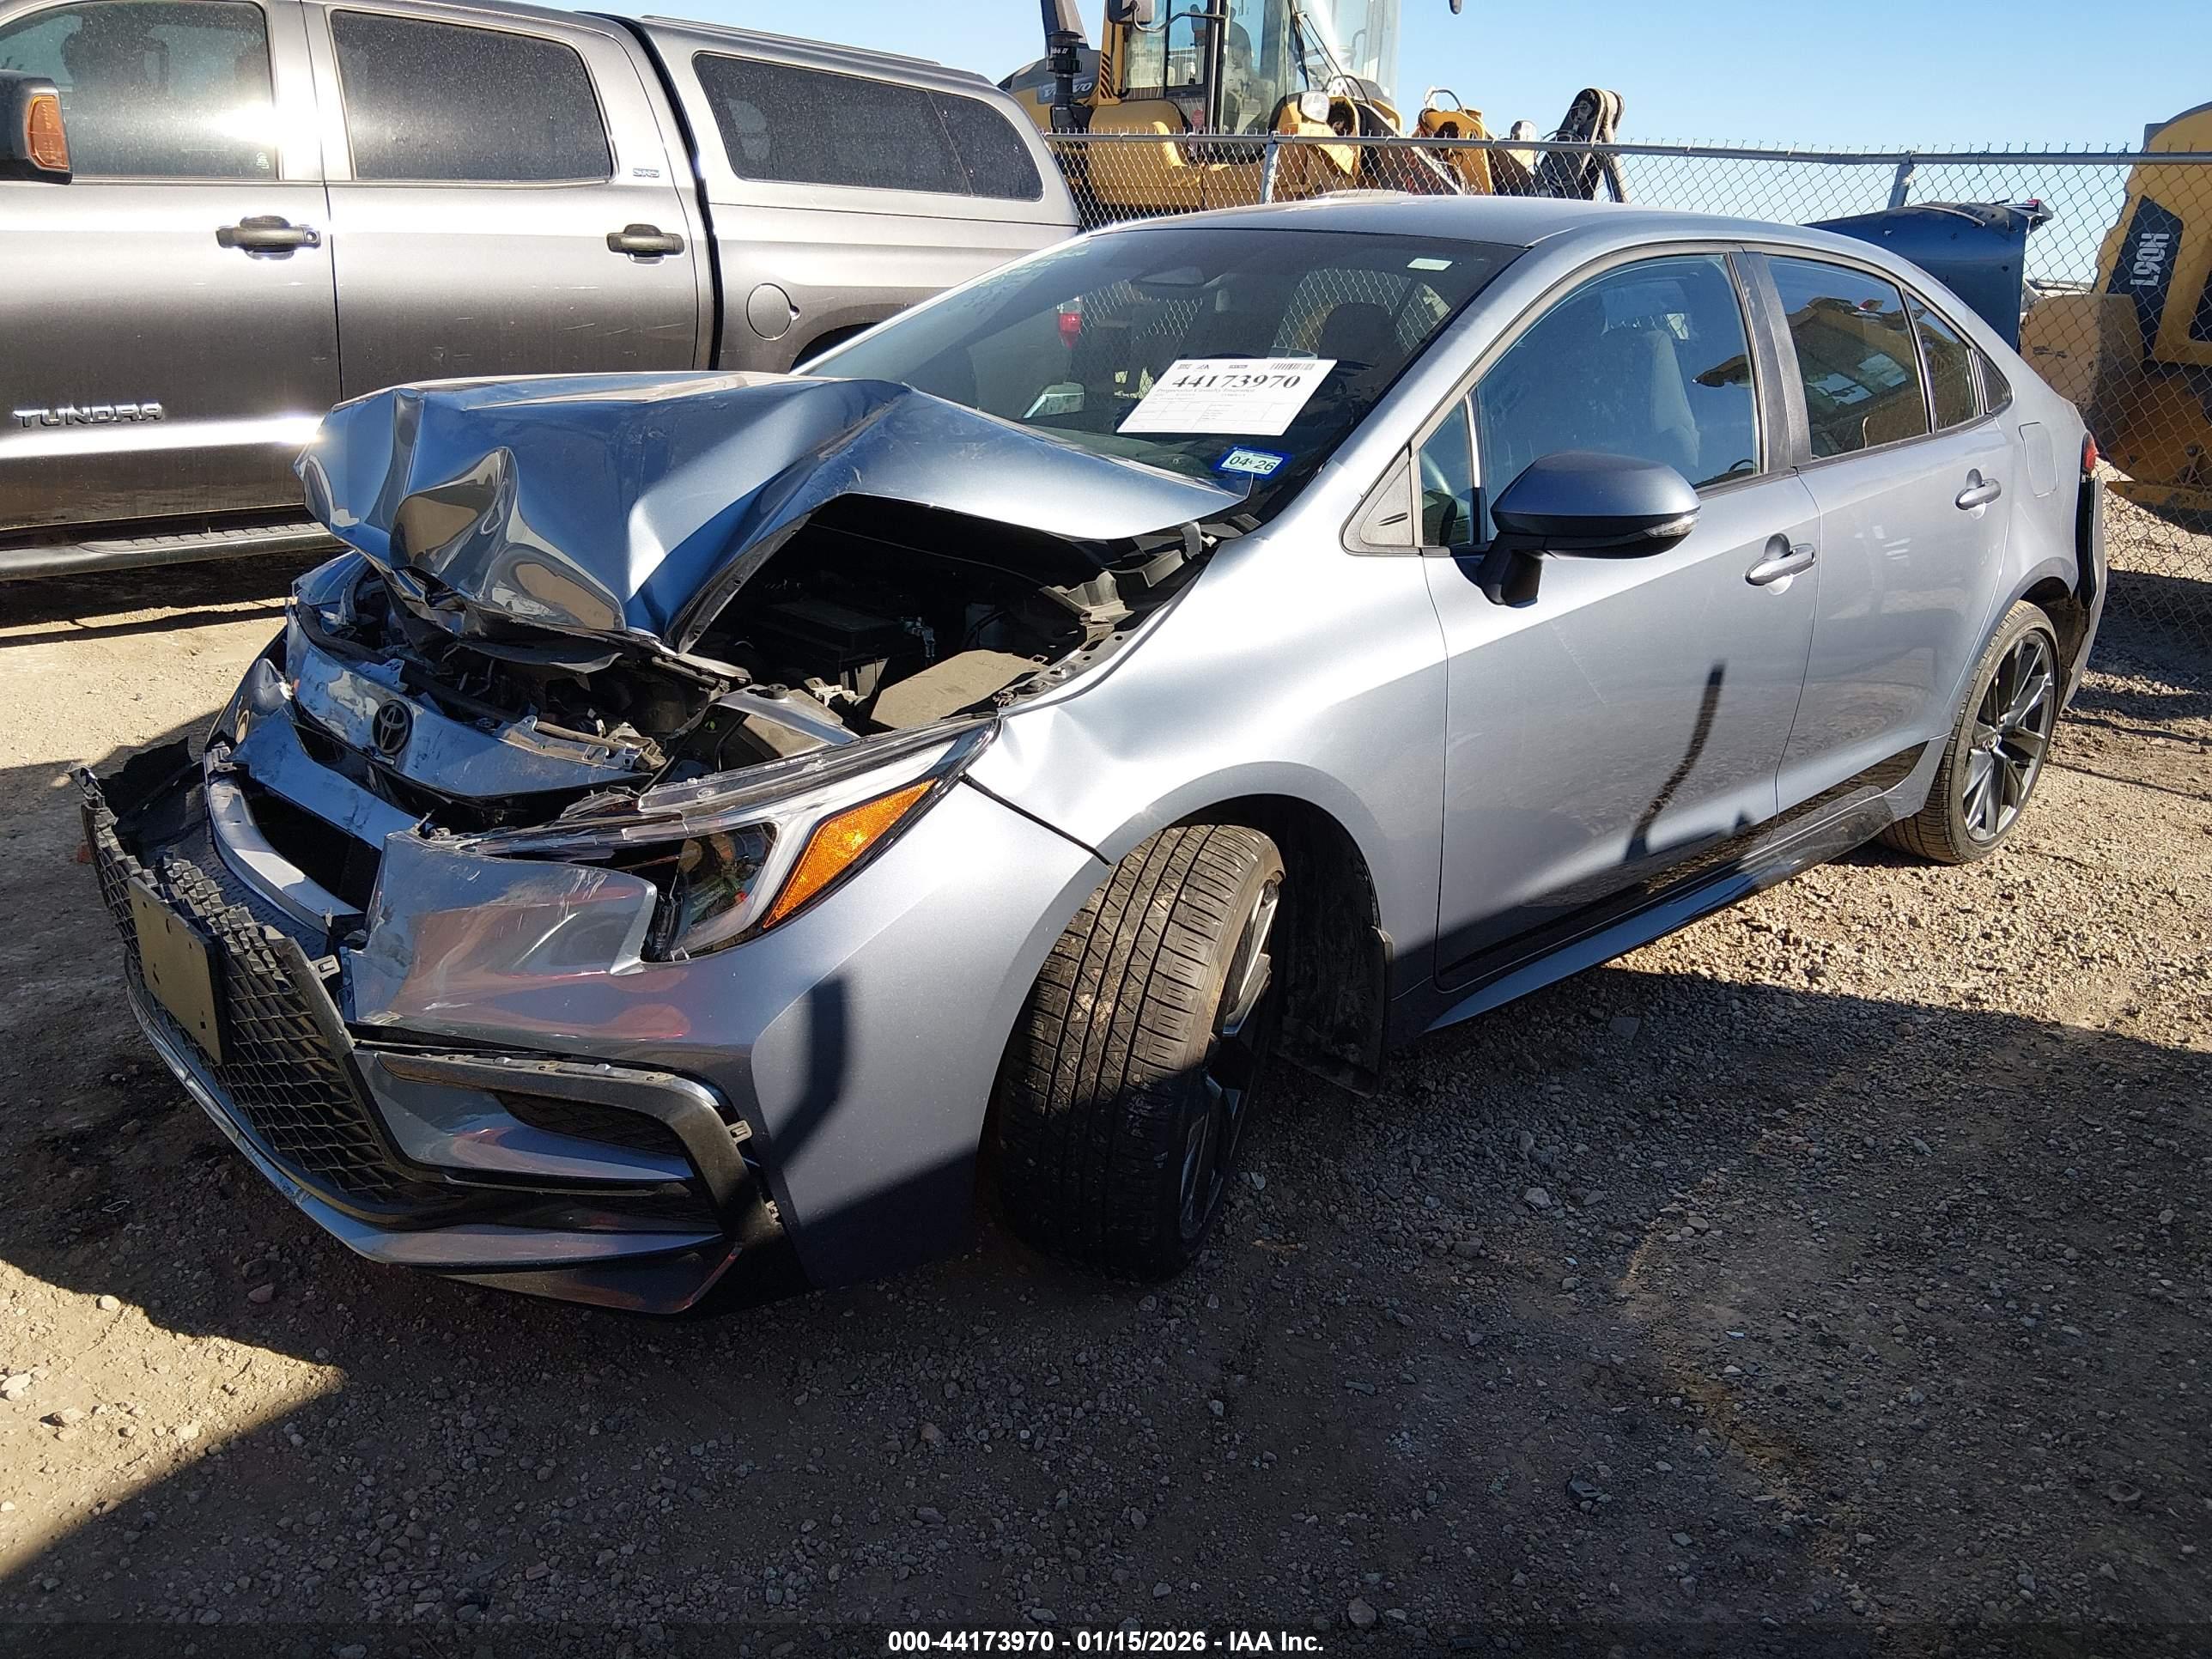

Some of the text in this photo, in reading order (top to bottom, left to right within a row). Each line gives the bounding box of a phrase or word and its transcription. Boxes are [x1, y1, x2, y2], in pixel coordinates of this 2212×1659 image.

[1043, 82, 1092, 98] VVO
[2130, 234, 2169, 286] L90H
[1172, 374, 1301, 388] 44173970
[13, 403, 163, 428] TUNDRA
[1229, 456, 1276, 471] 04 26
